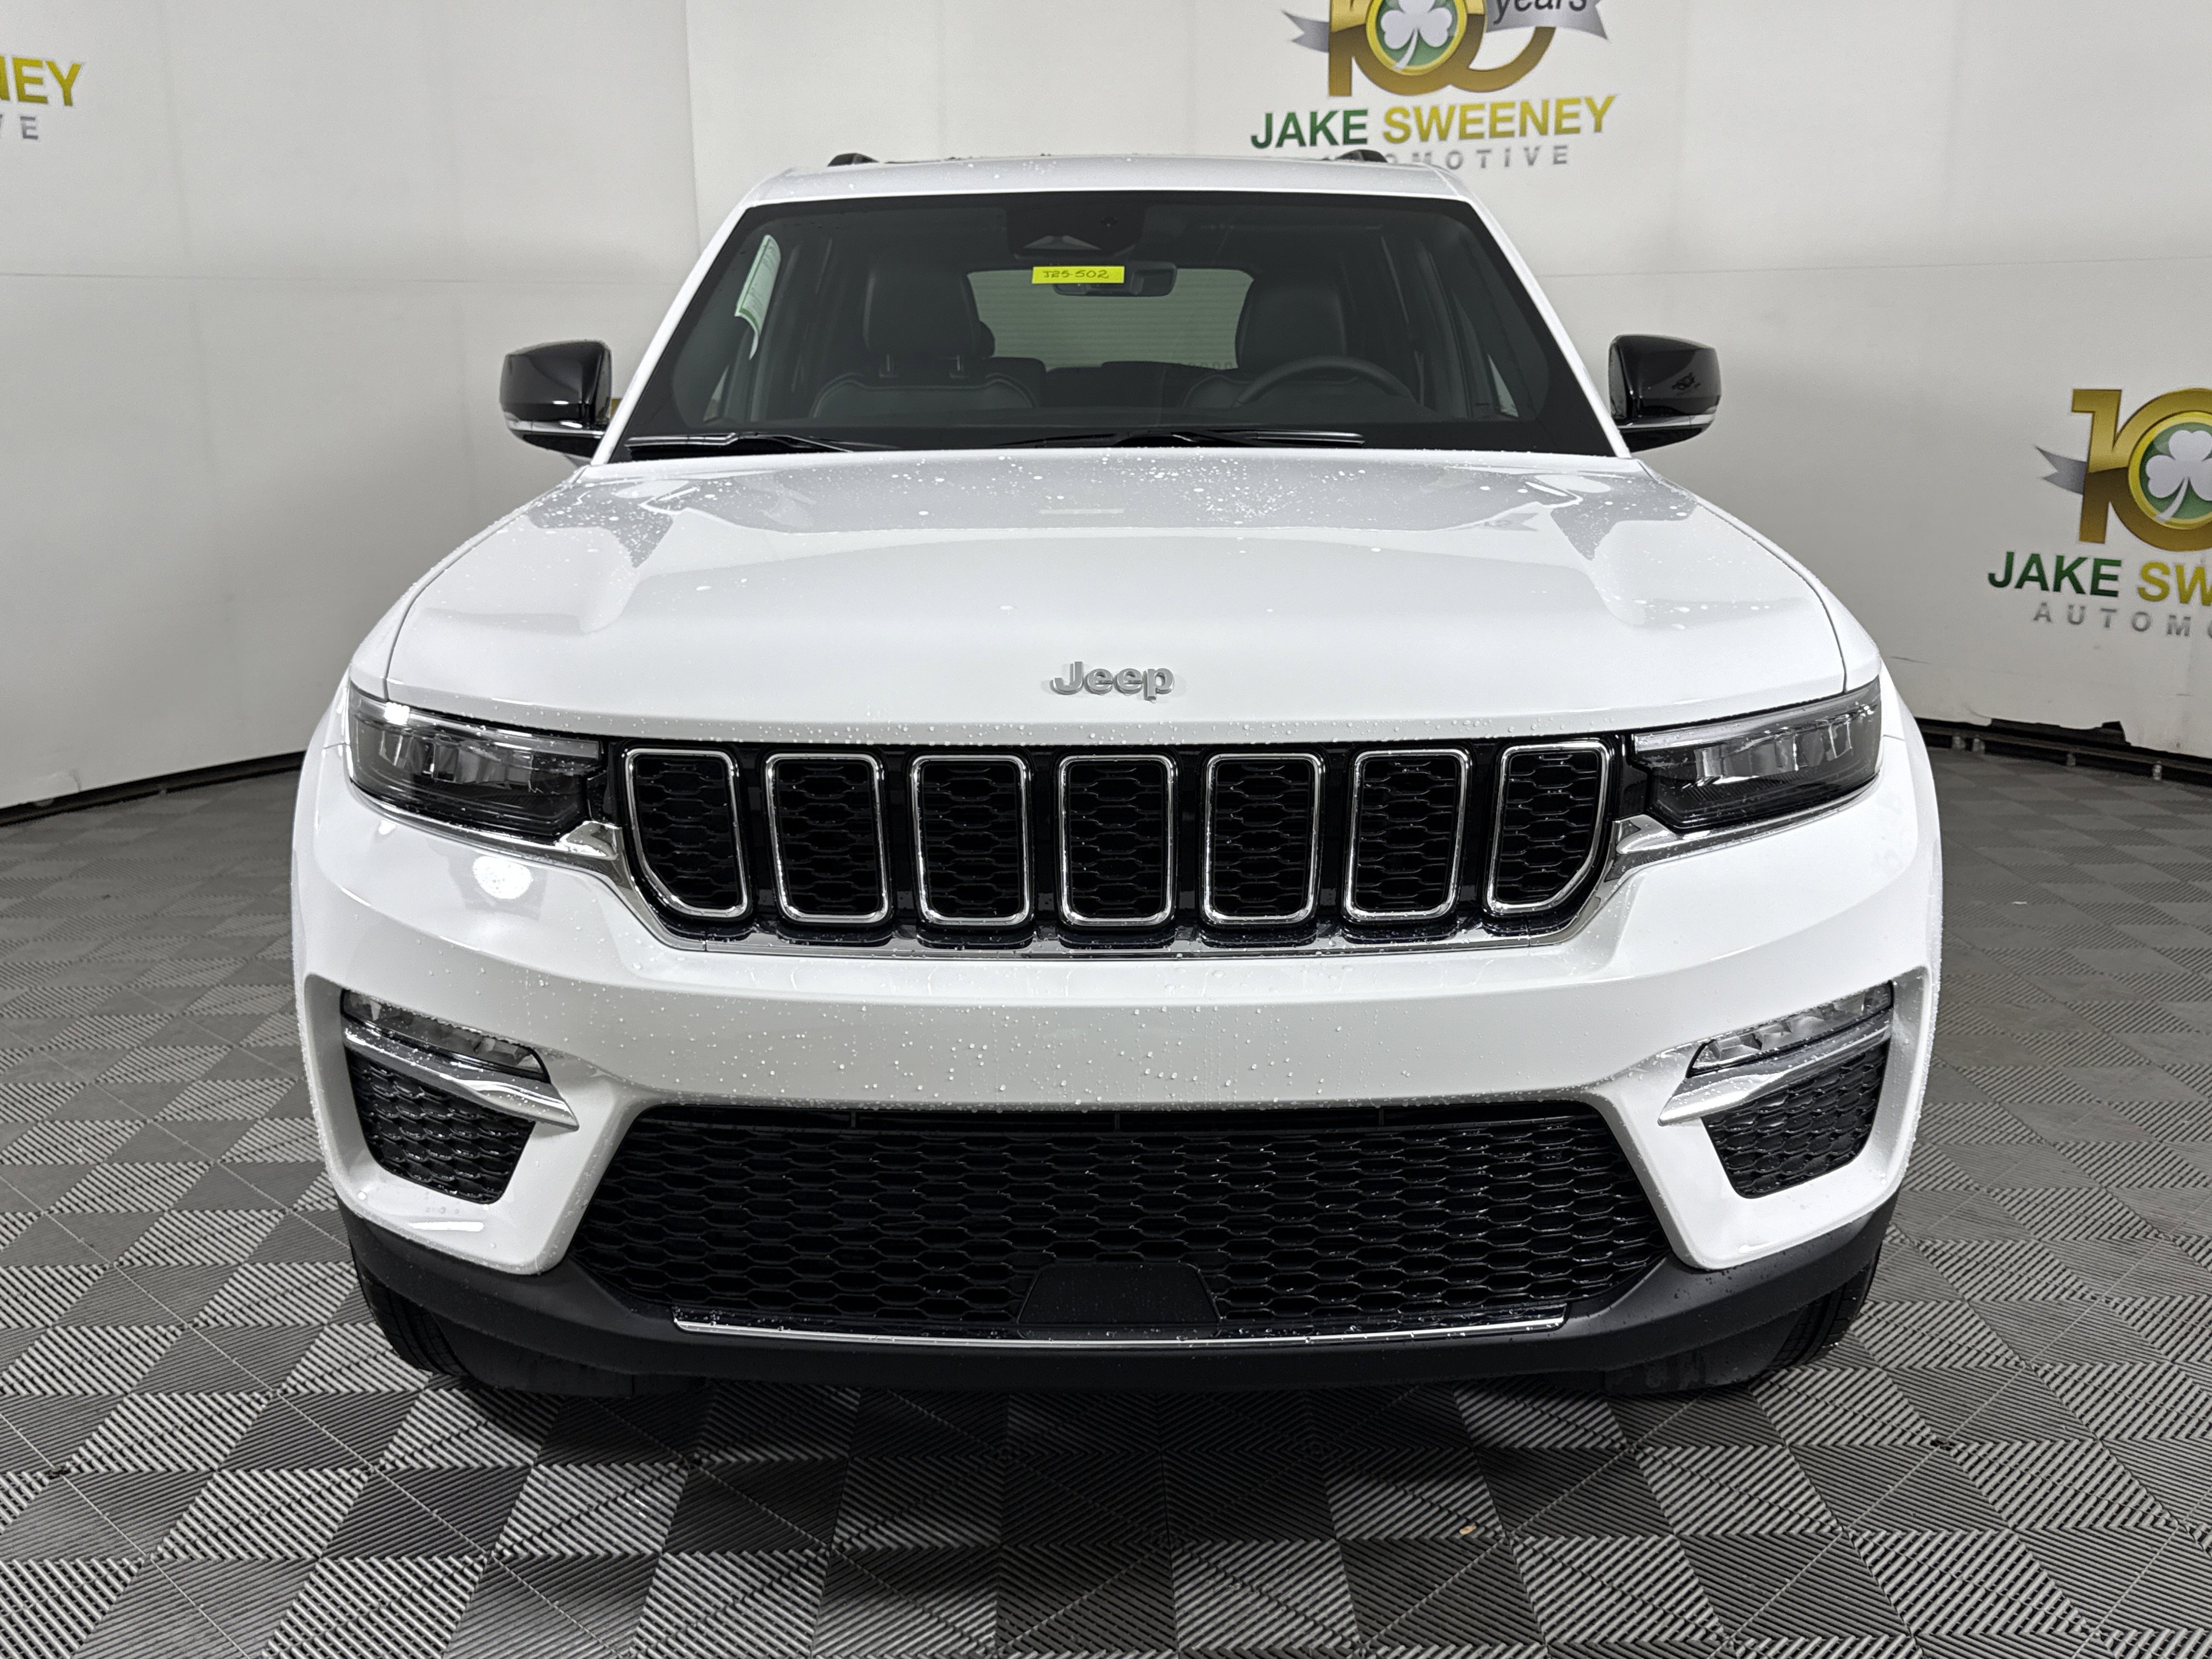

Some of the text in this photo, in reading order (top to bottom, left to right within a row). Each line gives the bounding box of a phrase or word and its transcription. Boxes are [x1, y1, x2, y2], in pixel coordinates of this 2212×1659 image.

[0, 57, 82, 106] EY
[1251, 96, 1616, 149] JAKE SWEENEY
[1988, 551, 2121, 597] JAKE
[2033, 602, 2212, 639] AUTOM
[1050, 662, 1174, 701] Jeep
